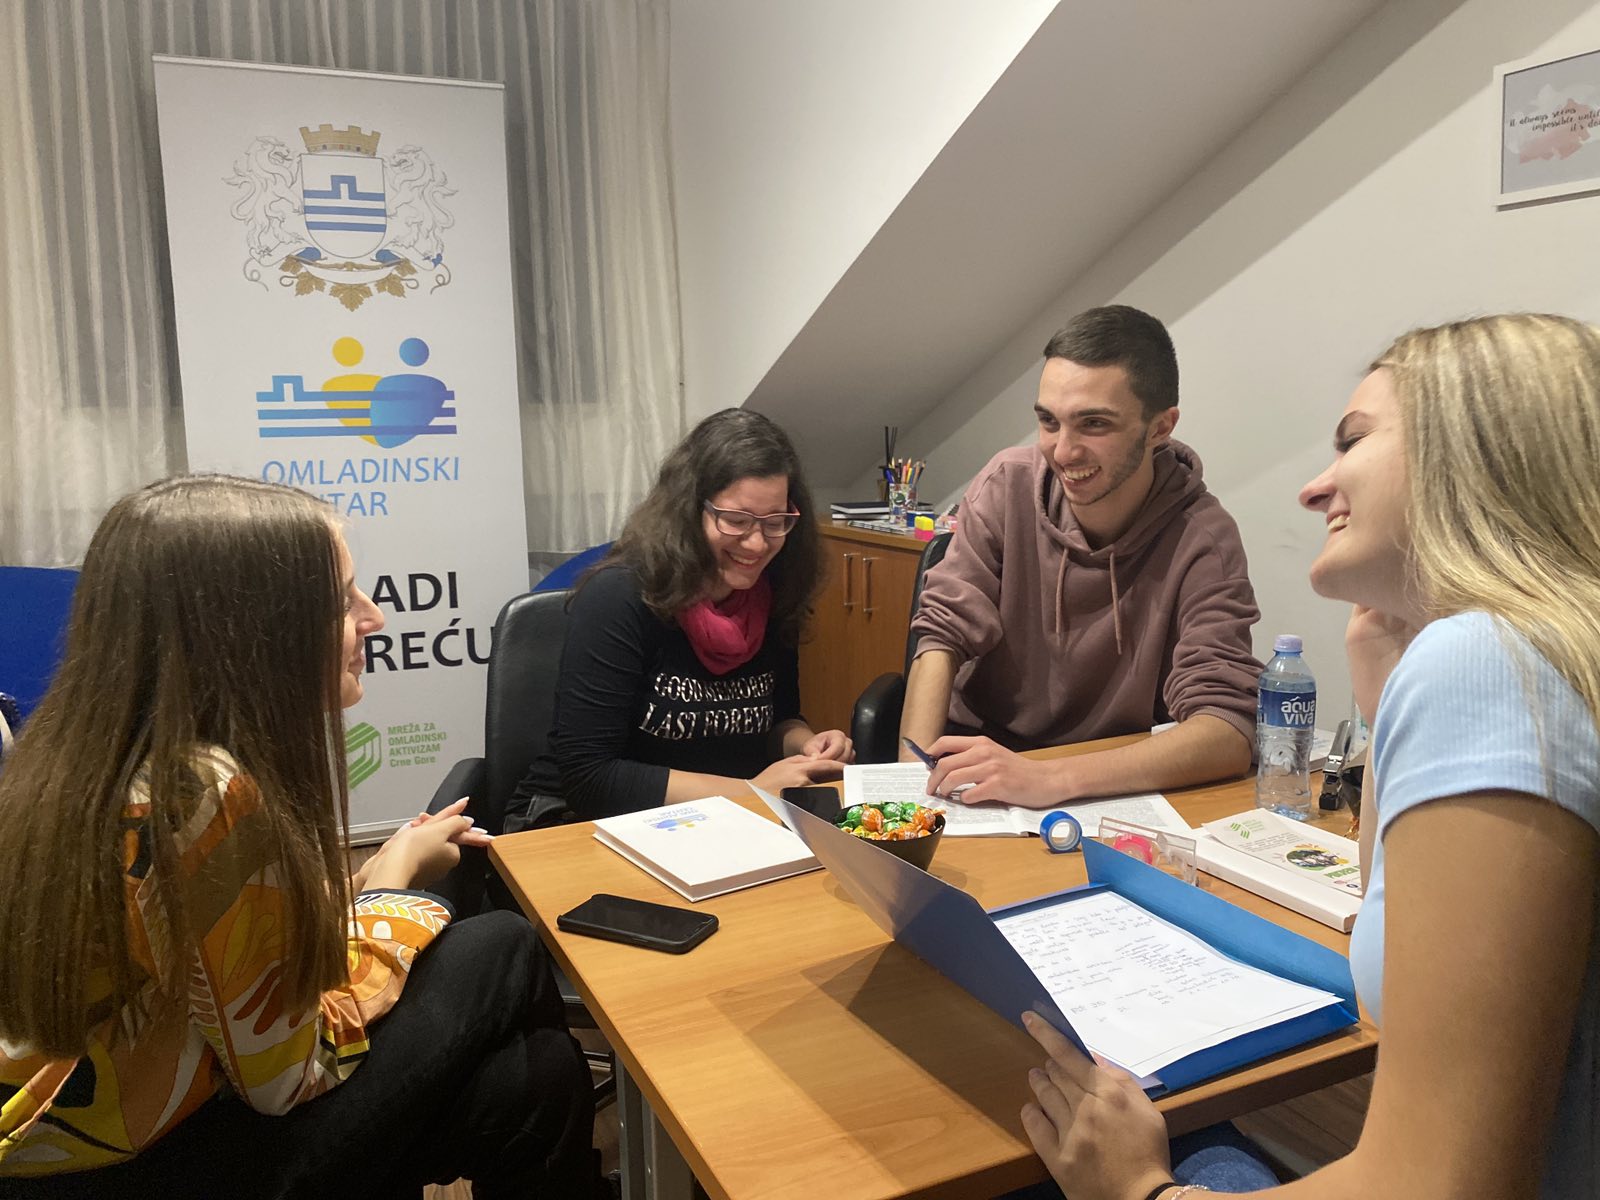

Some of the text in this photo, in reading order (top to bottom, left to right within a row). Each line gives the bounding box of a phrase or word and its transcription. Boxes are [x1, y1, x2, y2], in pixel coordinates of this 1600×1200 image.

[262, 456, 460, 486] OMLADINSKI
[319, 491, 389, 518] TAR
[371, 571, 459, 613] ADI
[364, 618, 495, 674] REĆU
[654, 672, 702, 703] GOOD
[387, 722, 436, 736] MREŽA ZA
[638, 702, 700, 740] LAST
[1283, 713, 1314, 725] viva
[388, 732, 447, 746] OMLADINSKI
[389, 743, 441, 757] AKTIVIZAM
[390, 757, 411, 768] Crne
